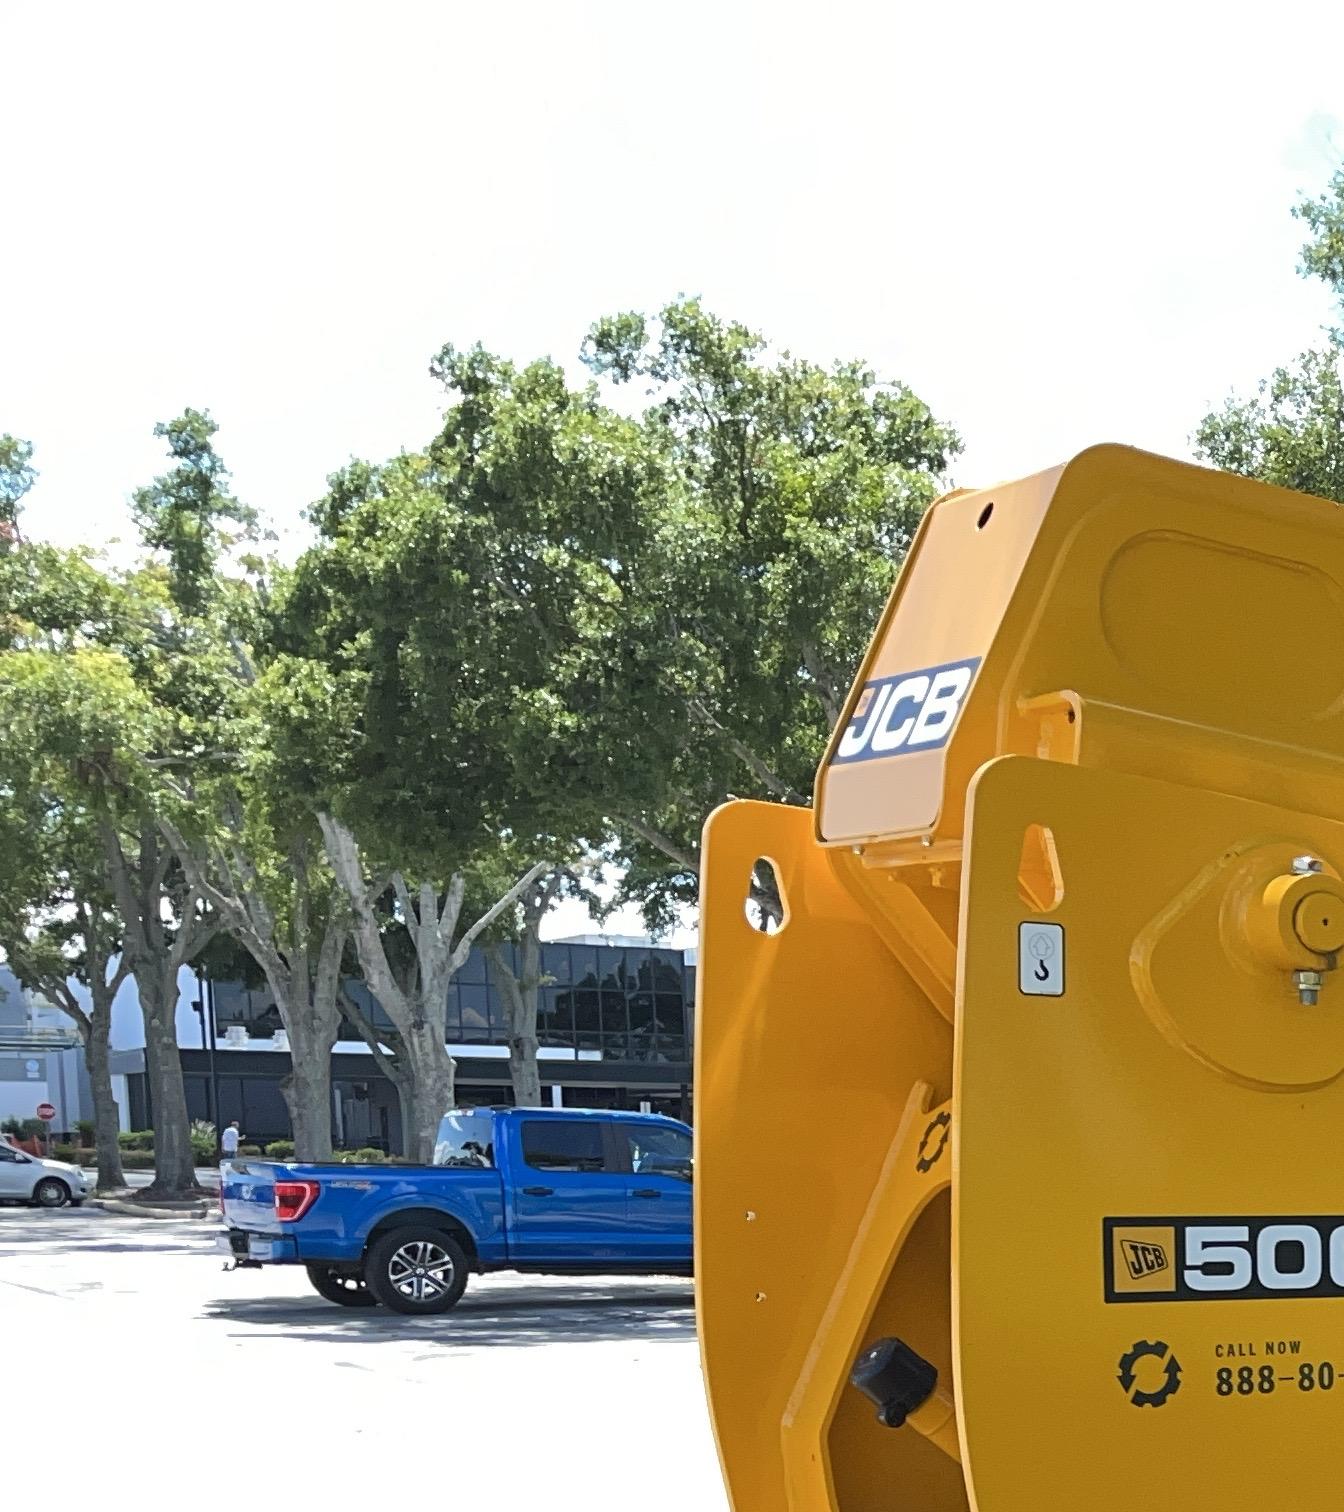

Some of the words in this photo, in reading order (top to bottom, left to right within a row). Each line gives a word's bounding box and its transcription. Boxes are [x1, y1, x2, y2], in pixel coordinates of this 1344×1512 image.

[838, 667, 972, 758] JCB
[1129, 1243, 1165, 1275] JCB
[1215, 1342, 1256, 1358] CALL
[1265, 1340, 1301, 1355] NOW
